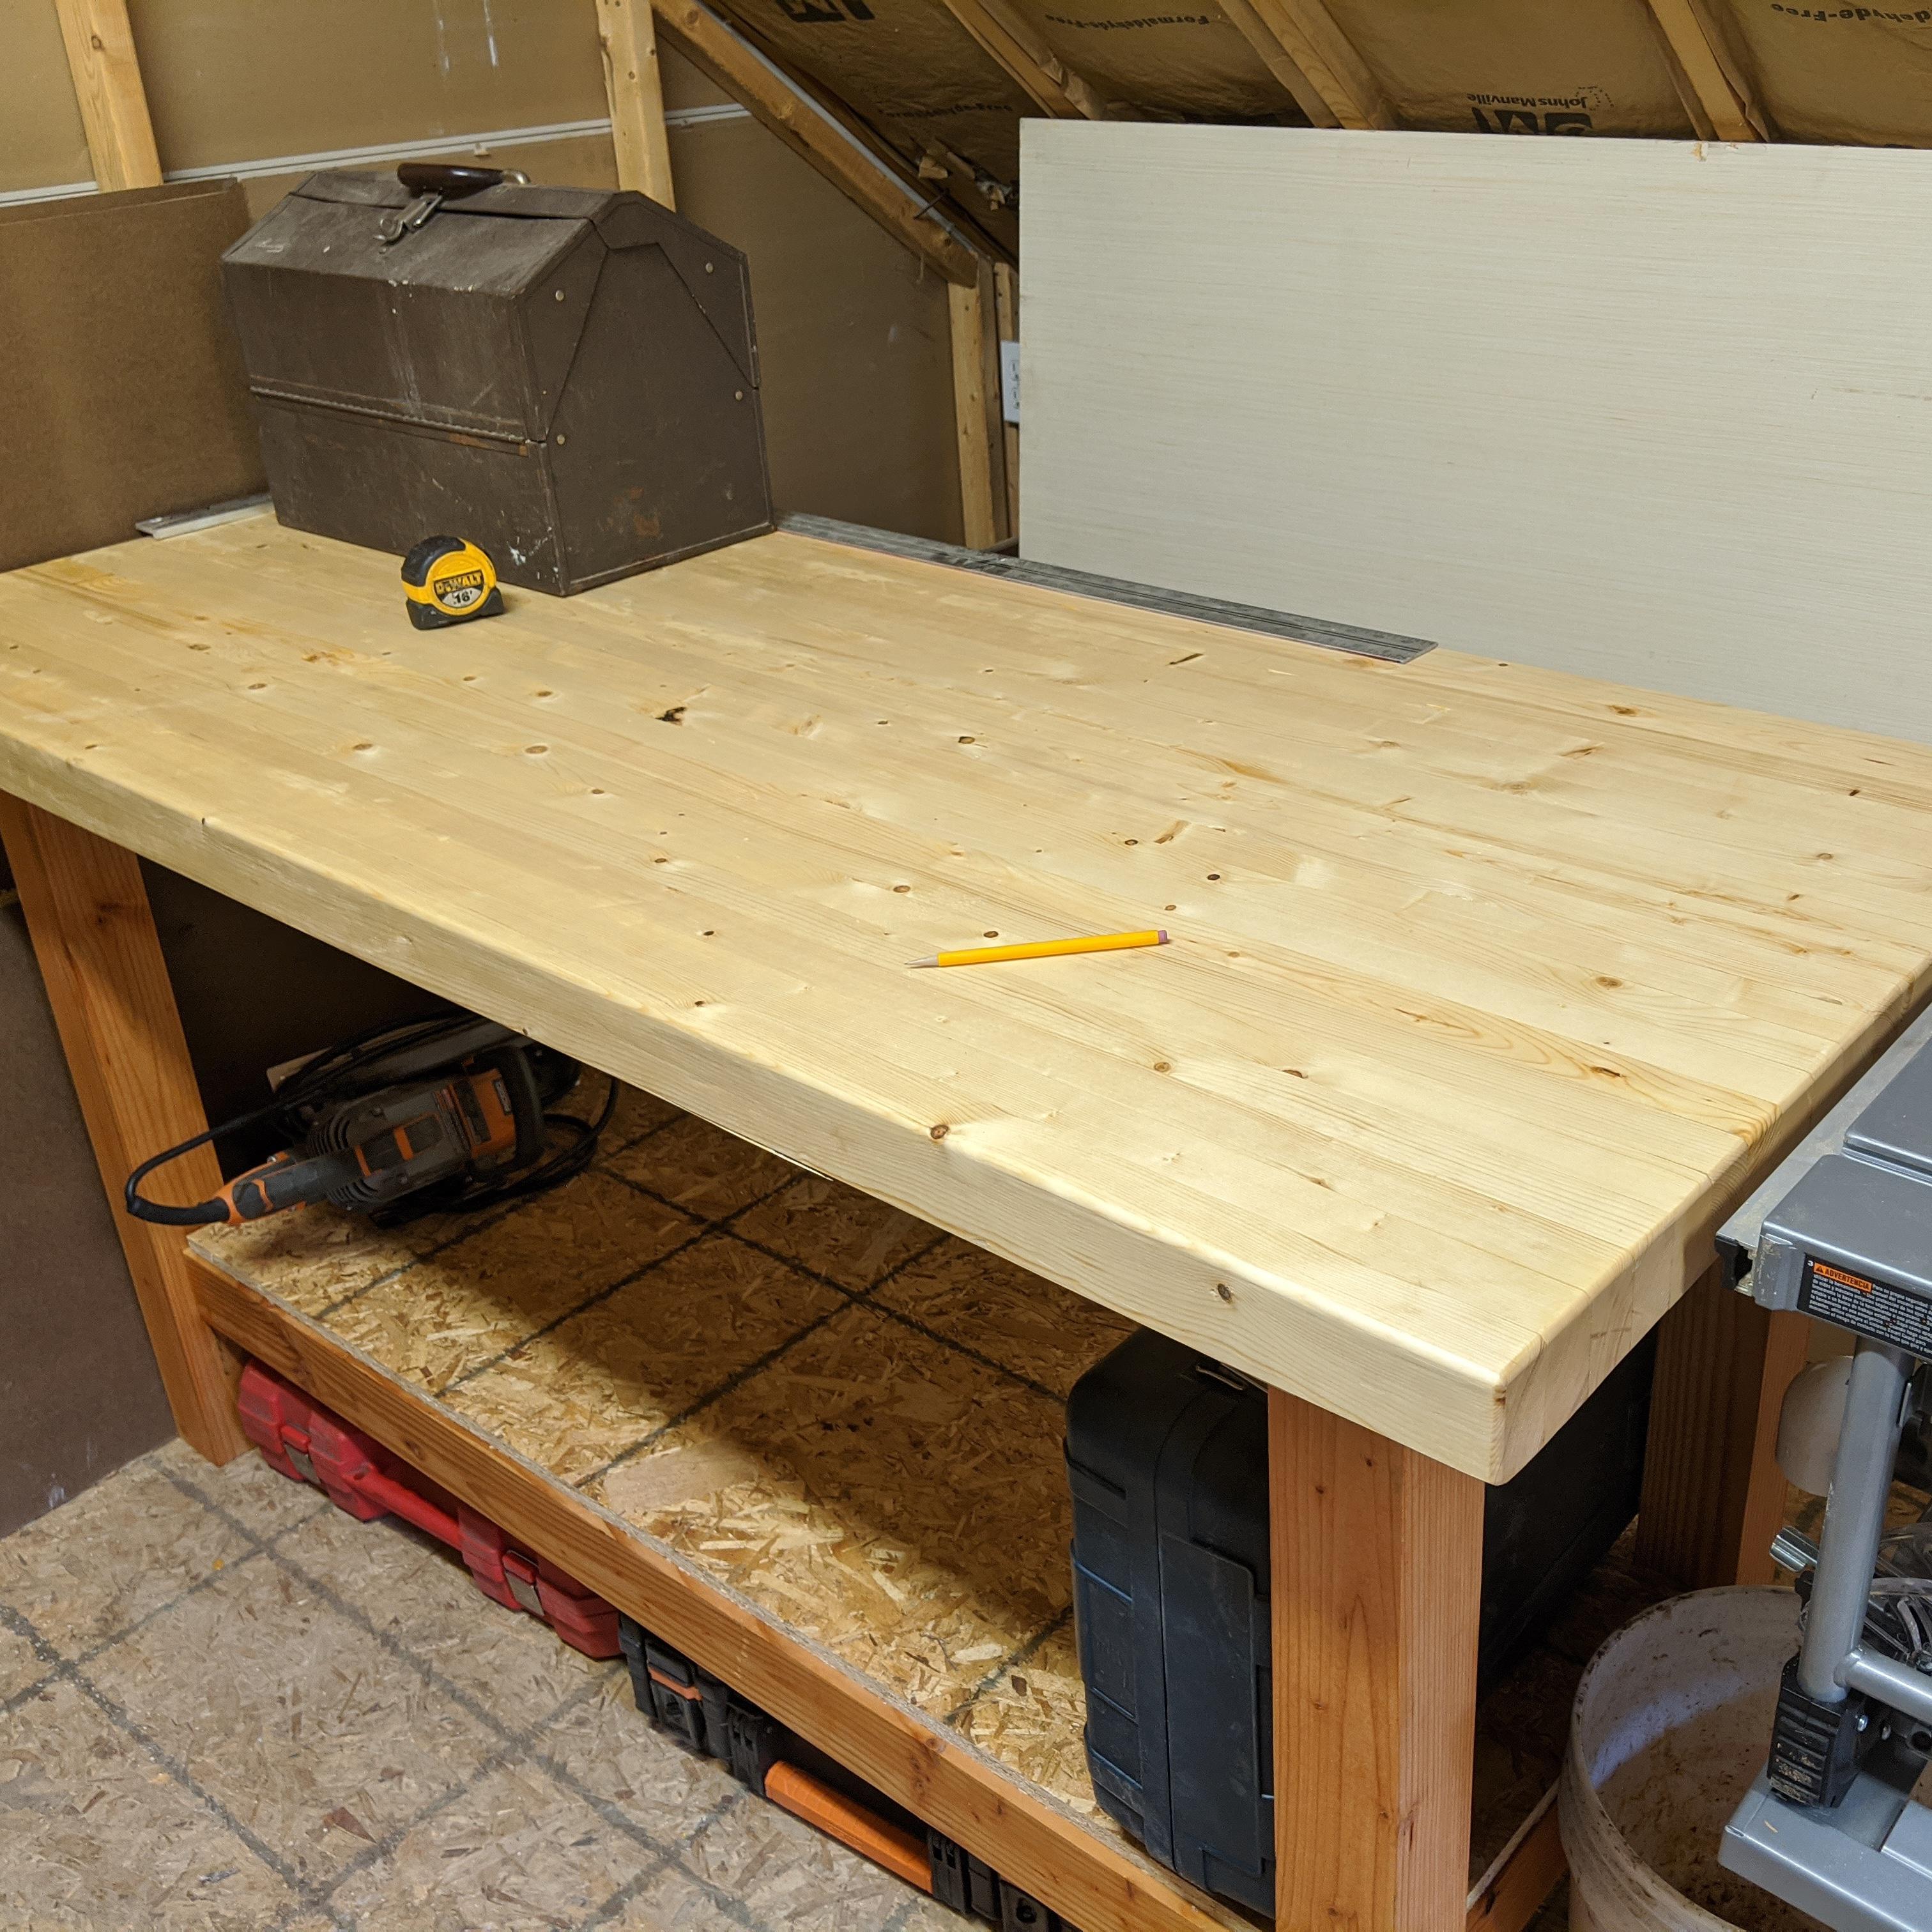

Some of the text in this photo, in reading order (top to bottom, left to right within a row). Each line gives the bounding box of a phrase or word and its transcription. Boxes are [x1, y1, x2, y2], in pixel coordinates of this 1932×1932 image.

[1045, 14, 1210, 31] Formaldehyde-Free
[1771, 3, 1932, 24] dehyde-Free
[1467, 93, 1588, 109] Johns Manville
[1825, 1269, 1869, 1290] ADVERTENCIA
